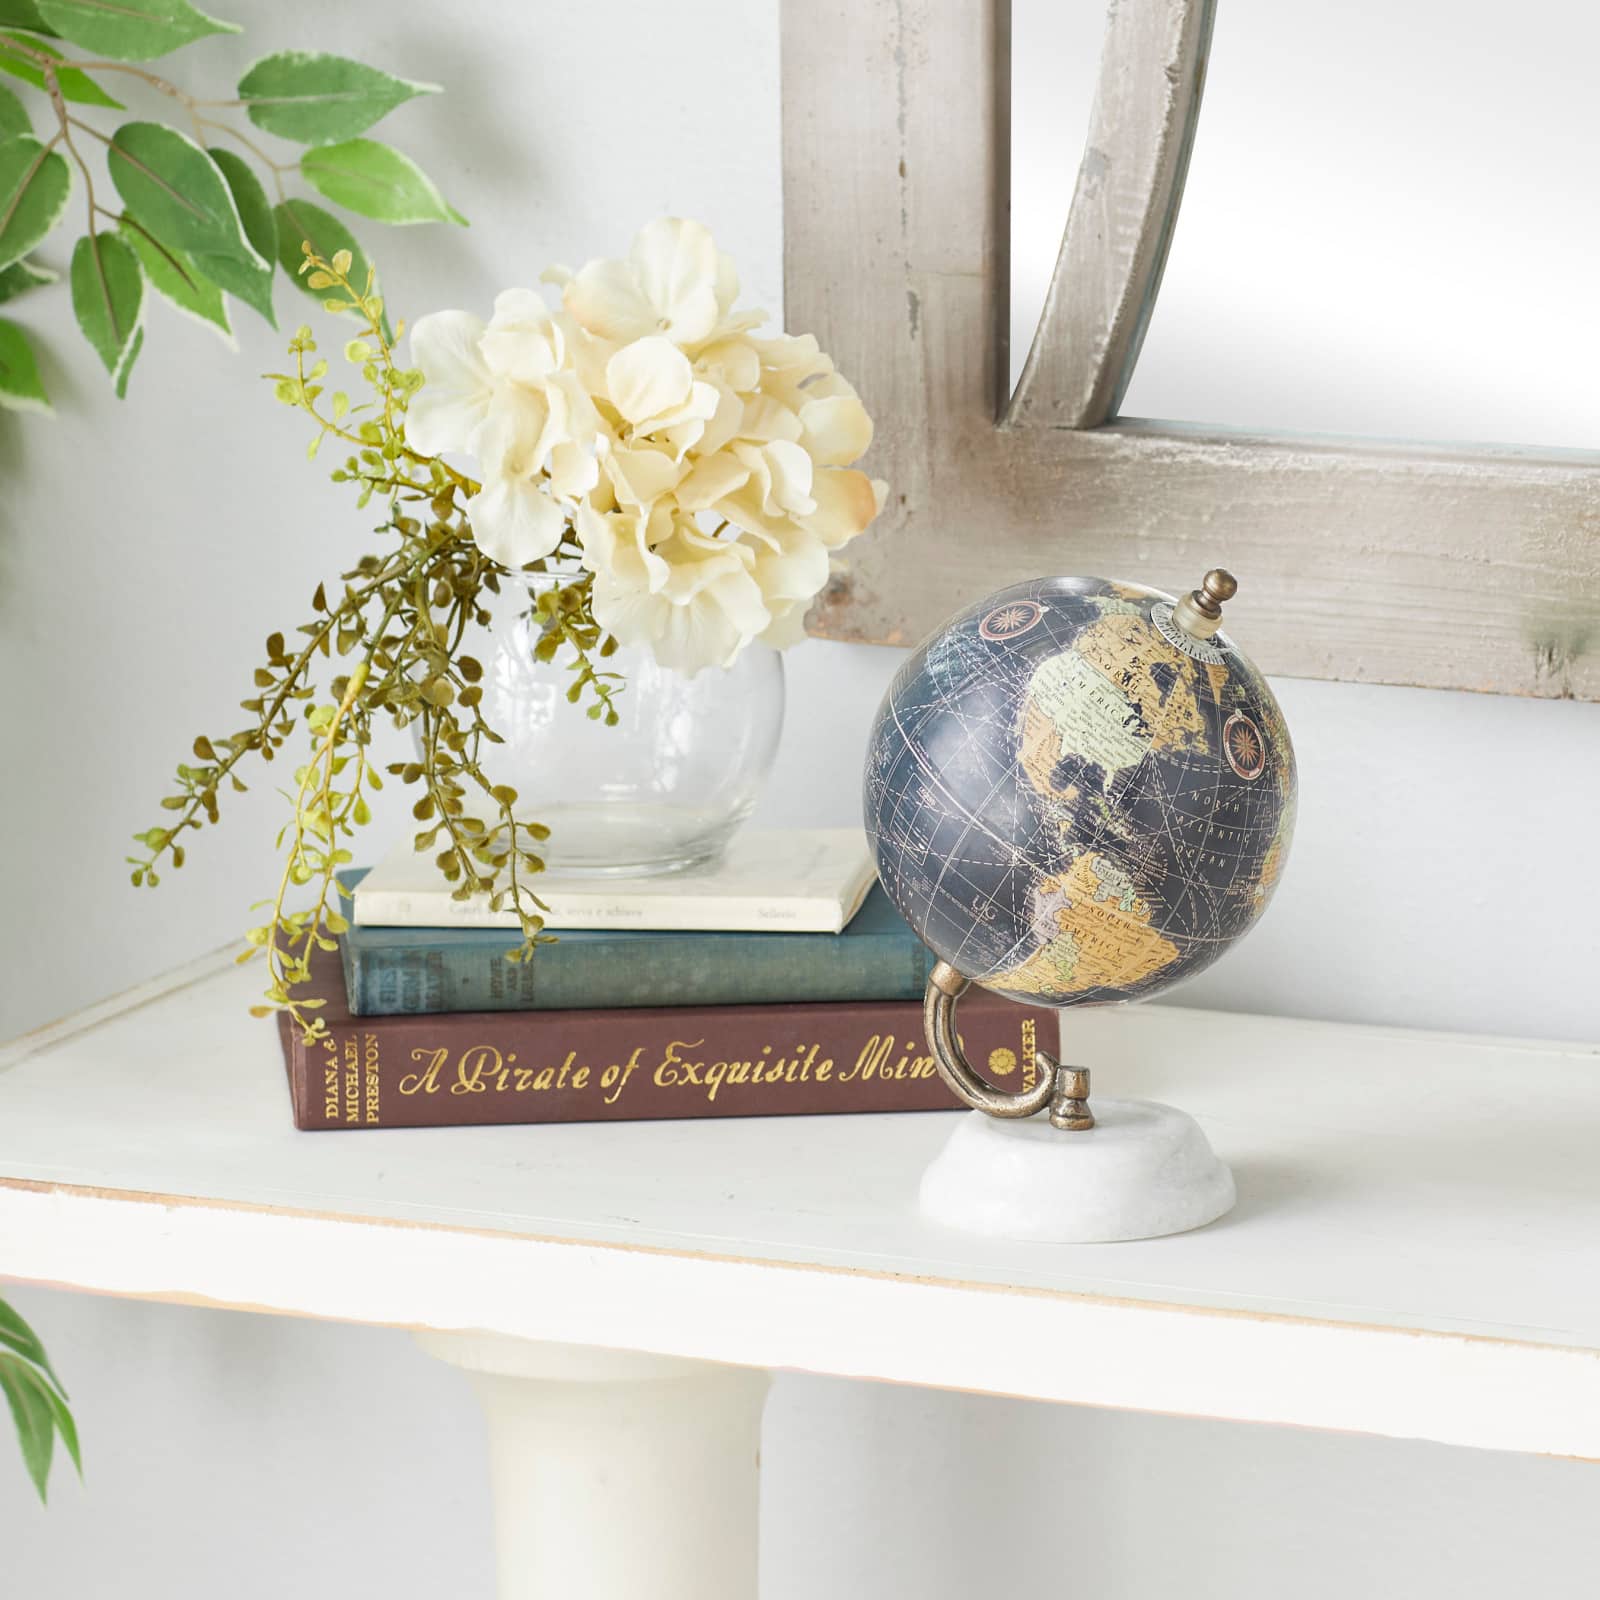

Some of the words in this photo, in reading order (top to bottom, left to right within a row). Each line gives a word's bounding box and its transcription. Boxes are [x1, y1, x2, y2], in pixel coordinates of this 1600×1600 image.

[1191, 790, 1240, 814] NORTH
[1176, 814, 1251, 844] ATLANTIC
[1176, 844, 1226, 869] OCEAN
[1088, 906, 1132, 930] SOUTH
[323, 1038, 337, 1053] &
[345, 1033, 360, 1123] MICHAEL
[365, 1033, 380, 1124] PRESTON
[399, 1047, 449, 1095] A
[451, 1045, 590, 1096] Pirate
[600, 1047, 647, 1105] of
[653, 1038, 834, 1102] Exquisite
[839, 1034, 966, 1084] Min
[325, 1055, 339, 1118] DIANA
